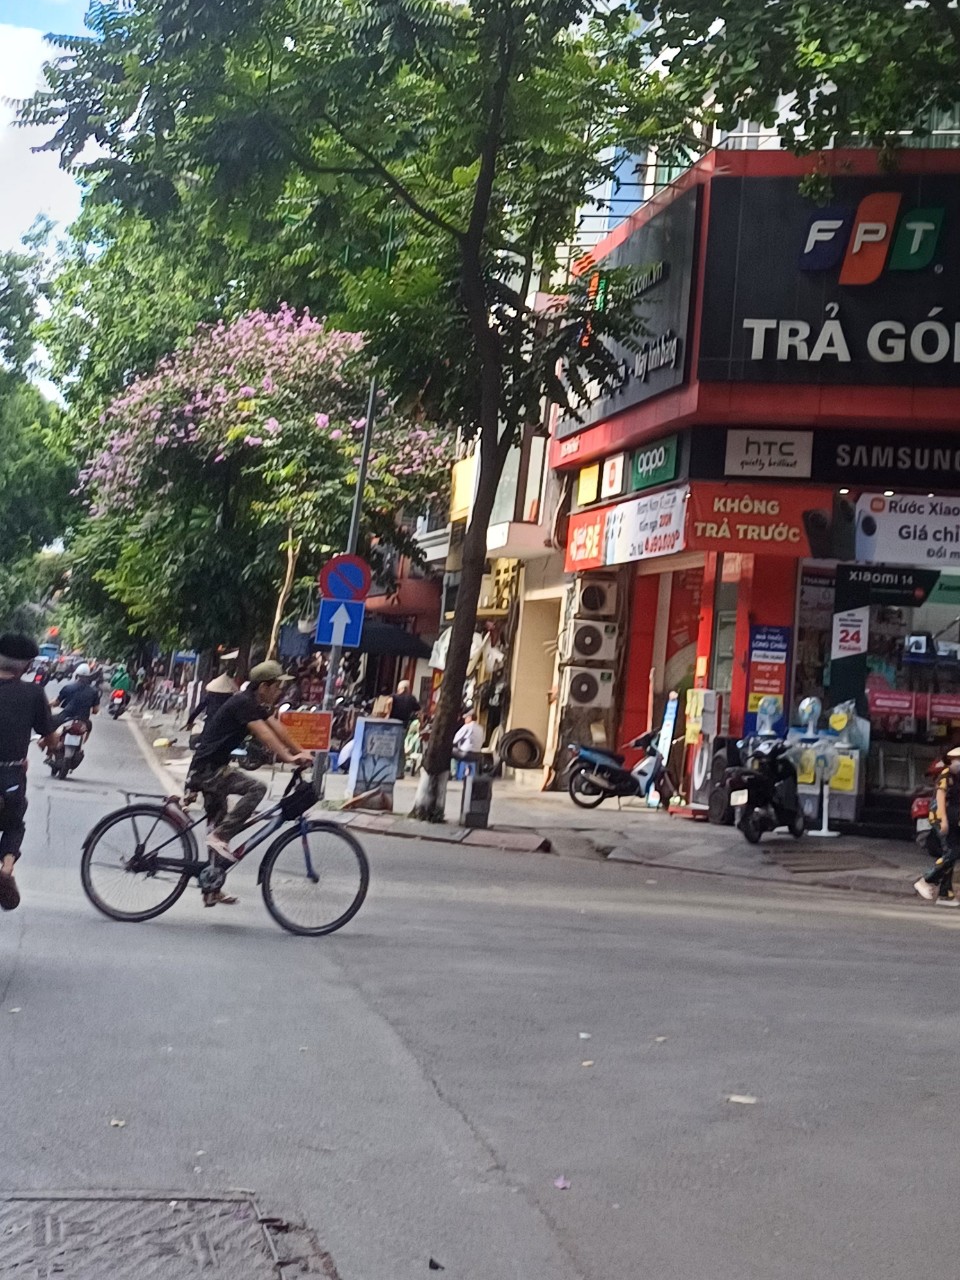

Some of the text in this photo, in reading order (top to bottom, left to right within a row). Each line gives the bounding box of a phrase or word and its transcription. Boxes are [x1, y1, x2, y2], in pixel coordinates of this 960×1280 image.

[804, 219, 936, 255] FPT
[742, 301, 851, 362] TRẢ
[713, 494, 780, 515] KHÔNG
[888, 497, 925, 514] Rước
[694, 516, 801, 543] TRẢ TRƯỚC
[898, 523, 928, 541] Giá
[933, 524, 960, 543] chỉ
[839, 628, 861, 644] 24
